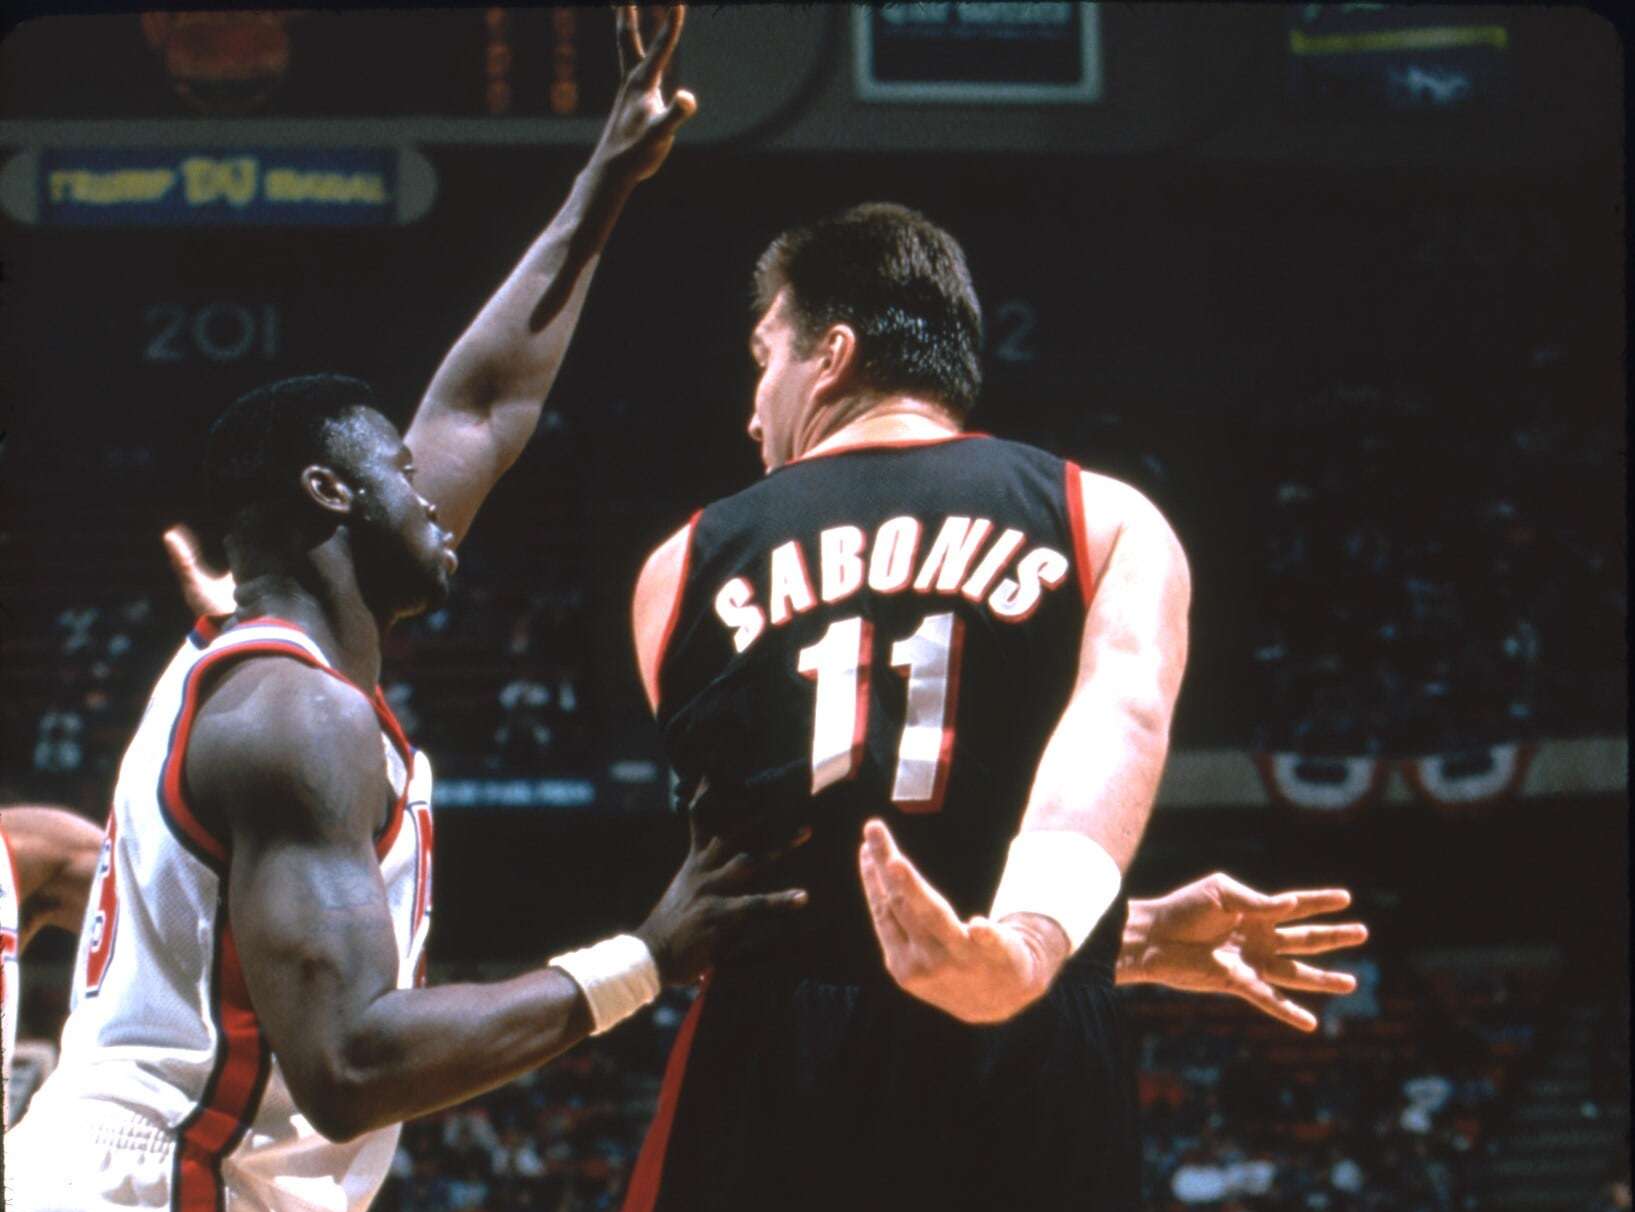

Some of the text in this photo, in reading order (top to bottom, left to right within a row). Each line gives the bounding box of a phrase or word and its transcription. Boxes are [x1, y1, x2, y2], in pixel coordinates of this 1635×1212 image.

[143, 305, 279, 363] 201
[714, 516, 1070, 653] SABONIS
[797, 612, 966, 814] 11
